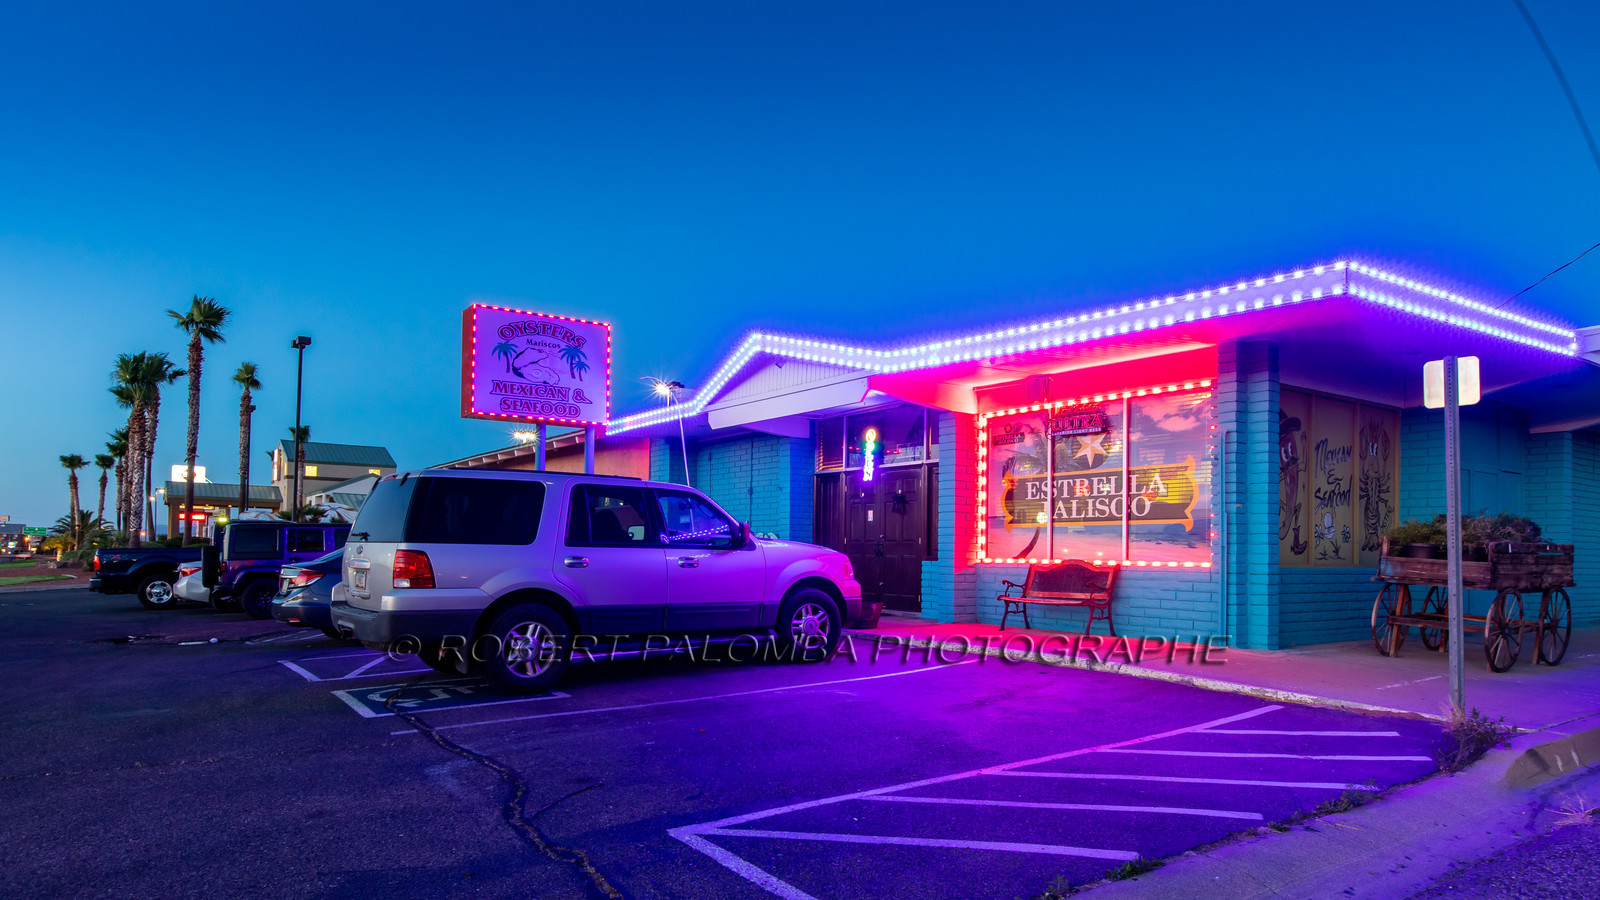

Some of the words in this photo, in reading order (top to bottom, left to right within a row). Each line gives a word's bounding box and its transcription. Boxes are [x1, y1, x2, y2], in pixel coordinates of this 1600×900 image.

[499, 320, 586, 349] OYSTERS
[526, 338, 561, 349] Mariscos
[493, 382, 569, 400] MEXICAN
[573, 389, 591, 404] &
[502, 399, 578, 416] SEAFOOD
[1051, 413, 1102, 431] ULTRA
[1025, 472, 1168, 500] ESTRELLA
